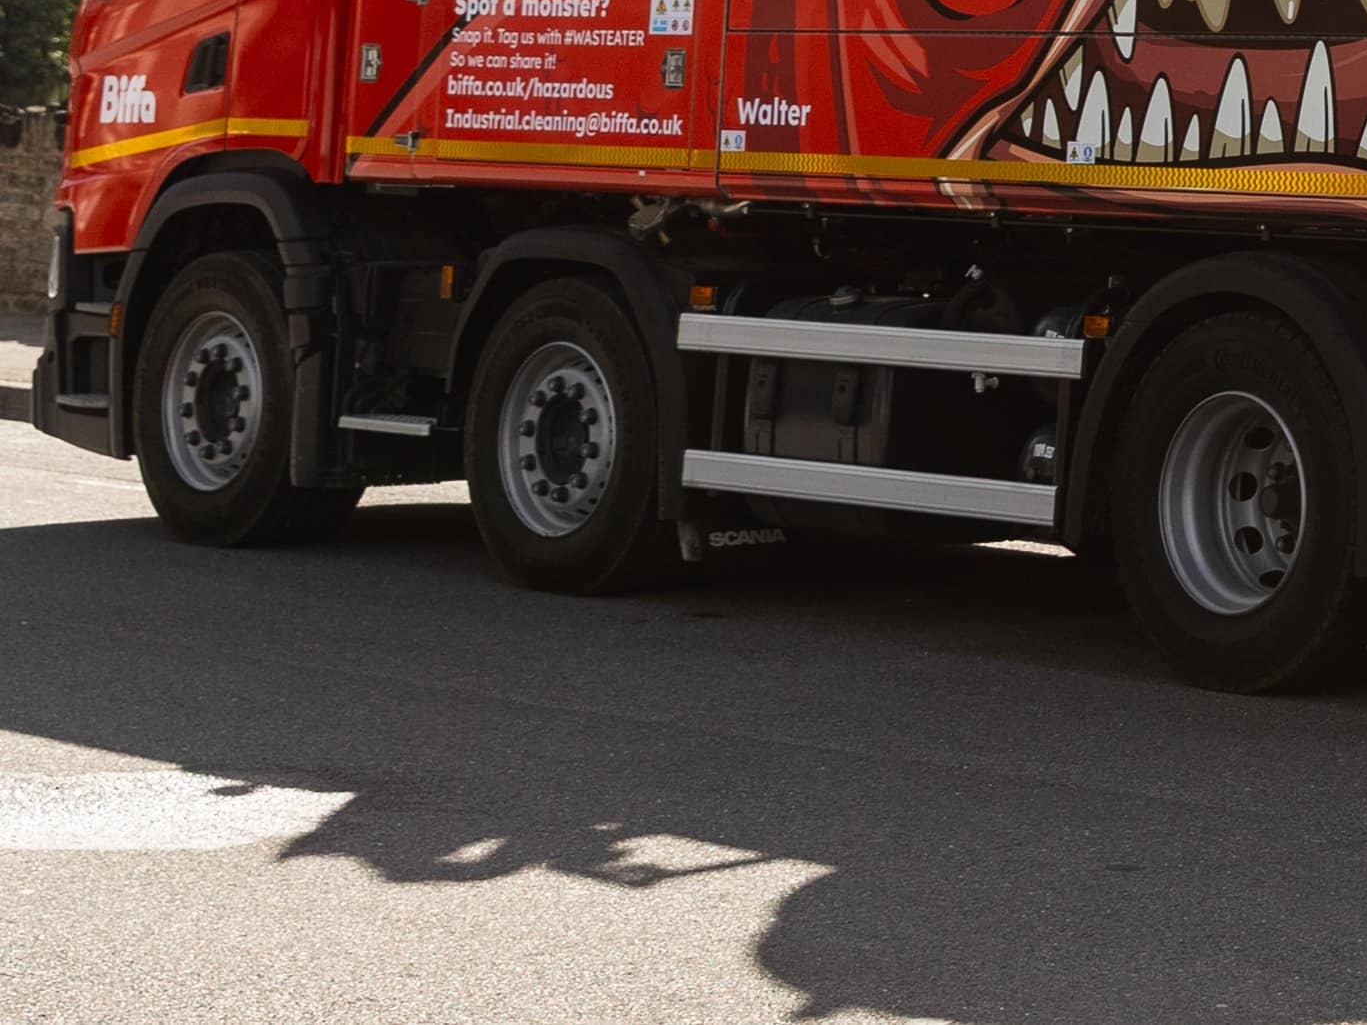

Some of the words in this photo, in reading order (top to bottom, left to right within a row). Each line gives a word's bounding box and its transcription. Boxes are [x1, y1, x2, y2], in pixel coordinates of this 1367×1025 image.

[452, 27, 481, 47] Snap
[483, 27, 495, 44] it.
[497, 28, 519, 49] Tag
[520, 32, 535, 45] us
[537, 28, 562, 45] with
[563, 30, 645, 46] #WASTEATER
[449, 51, 466, 67] So
[467, 55, 485, 68] we
[486, 55, 508, 68] can
[509, 53, 543, 70] share
[544, 53, 557, 70] it!
[100, 74, 156, 124] Biffa
[447, 75, 614, 100] biffa.co.uk/hazardous
[445, 109, 683, 137] Industrial.cleaning@biffa.co.uk
[737, 97, 811, 126] Walter
[708, 528, 787, 547] SCANIA
